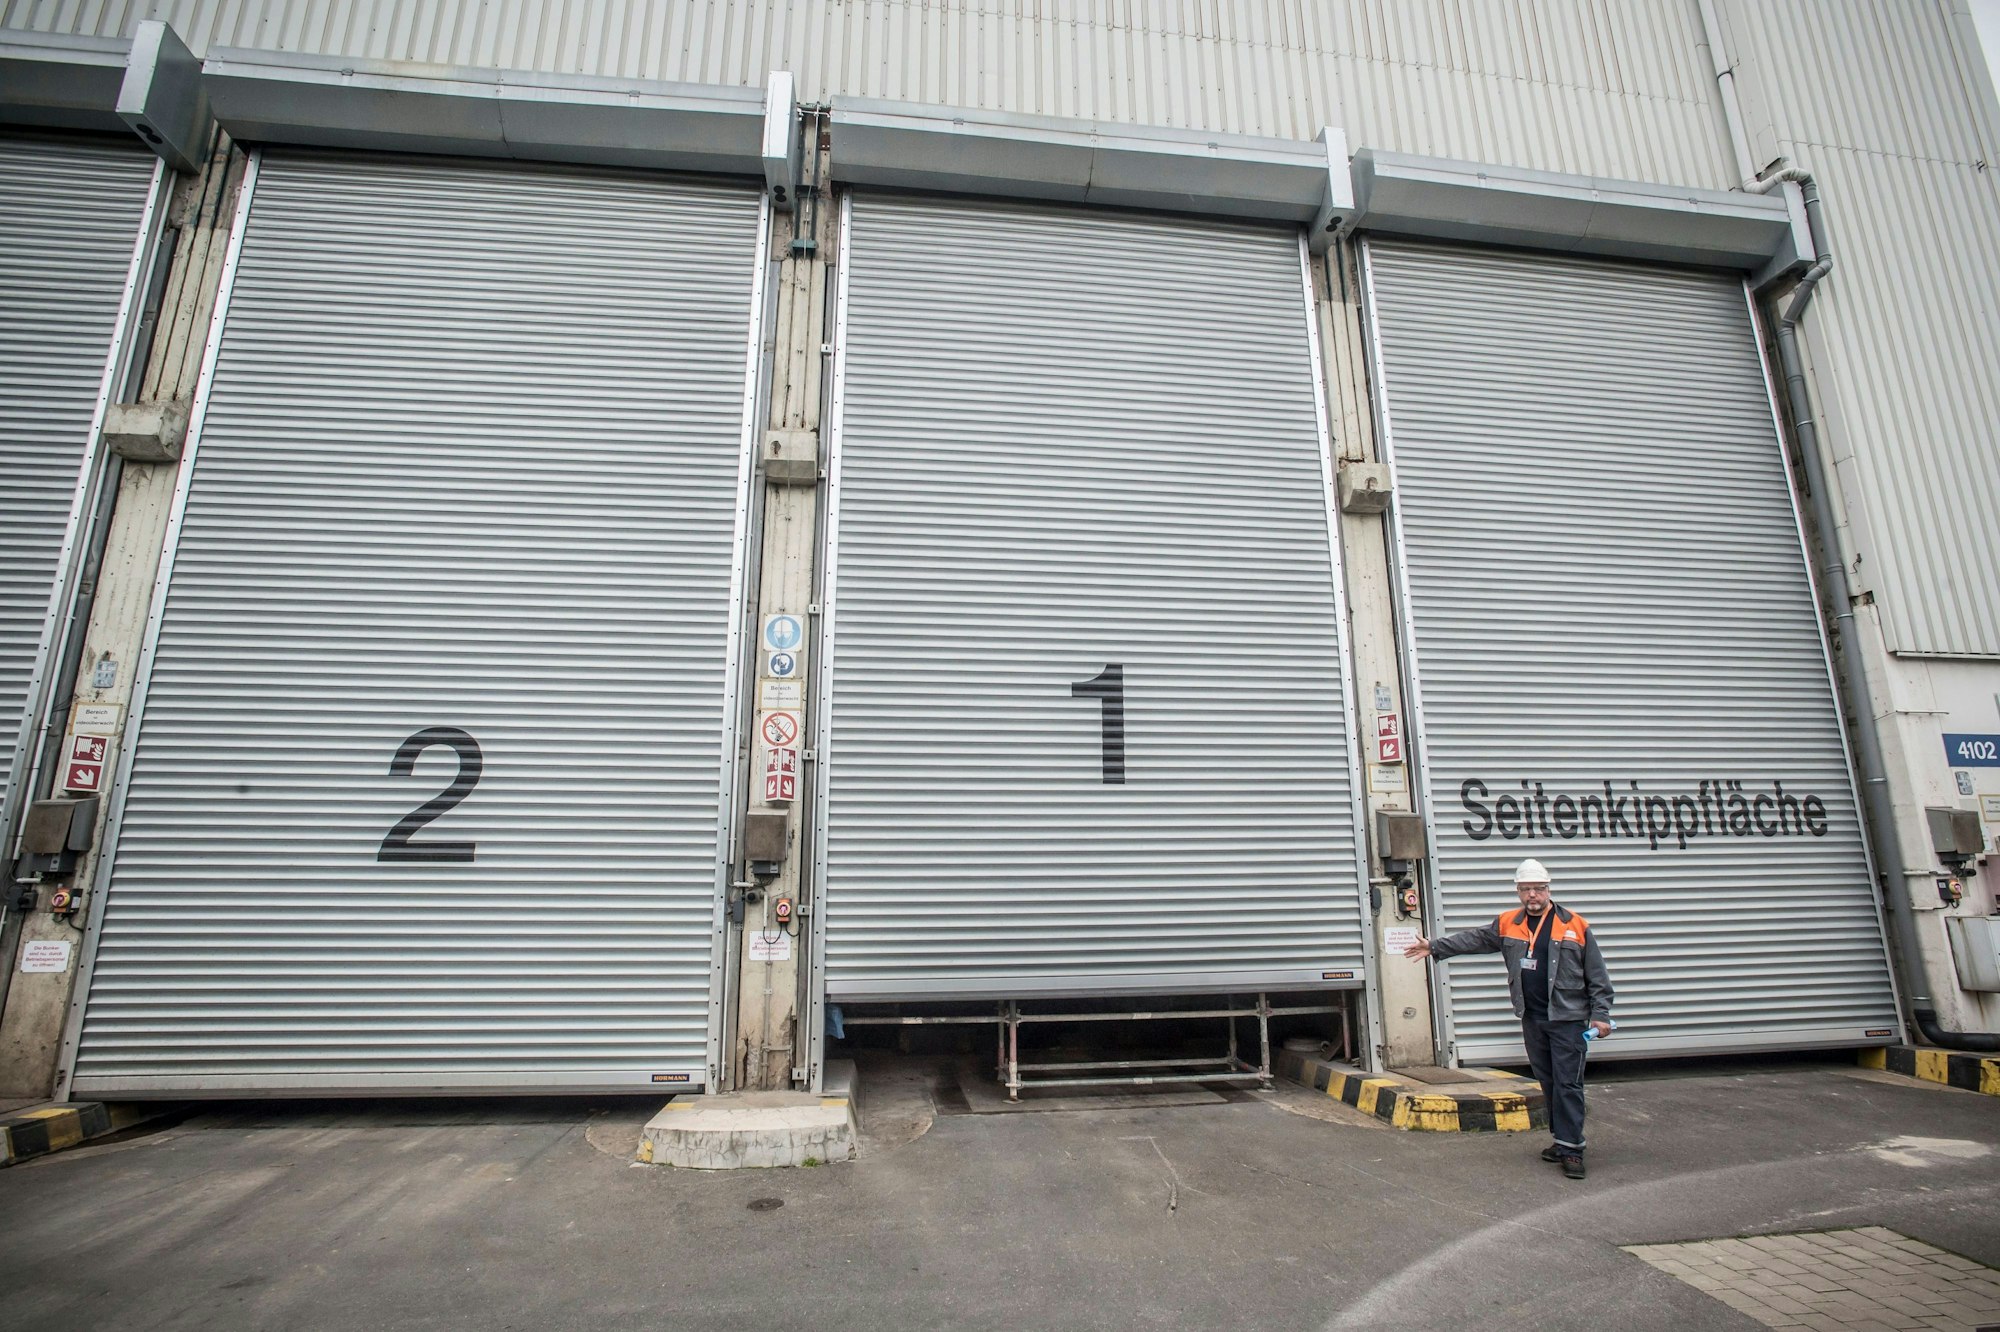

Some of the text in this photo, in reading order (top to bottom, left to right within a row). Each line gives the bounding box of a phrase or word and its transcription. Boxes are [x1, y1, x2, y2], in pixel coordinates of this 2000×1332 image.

[1071, 664, 1125, 784] 1
[1958, 741, 1998, 760] 4102
[377, 727, 483, 862] 2
[1460, 777, 1828, 850] Seitenkippfläche
